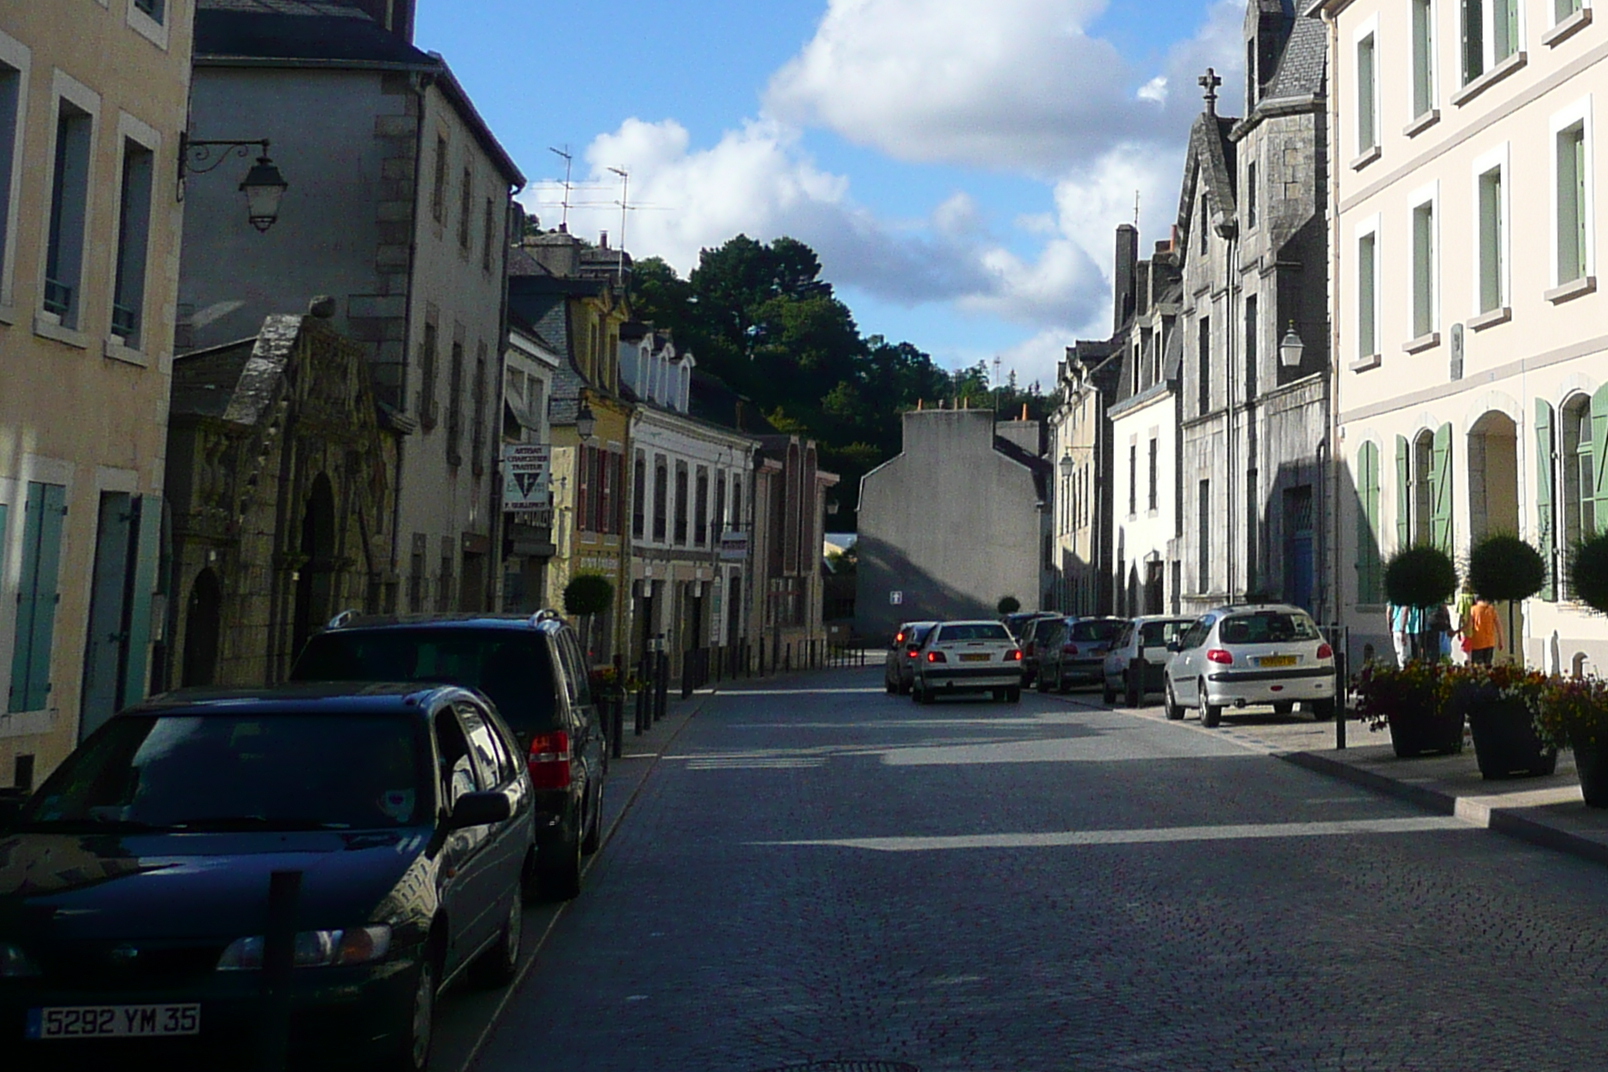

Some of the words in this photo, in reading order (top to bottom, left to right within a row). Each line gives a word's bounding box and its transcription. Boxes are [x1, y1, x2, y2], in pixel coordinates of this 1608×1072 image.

[46, 1009, 114, 1035] 5292
[125, 1008, 156, 1033] YM
[163, 1007, 197, 1032] 35
